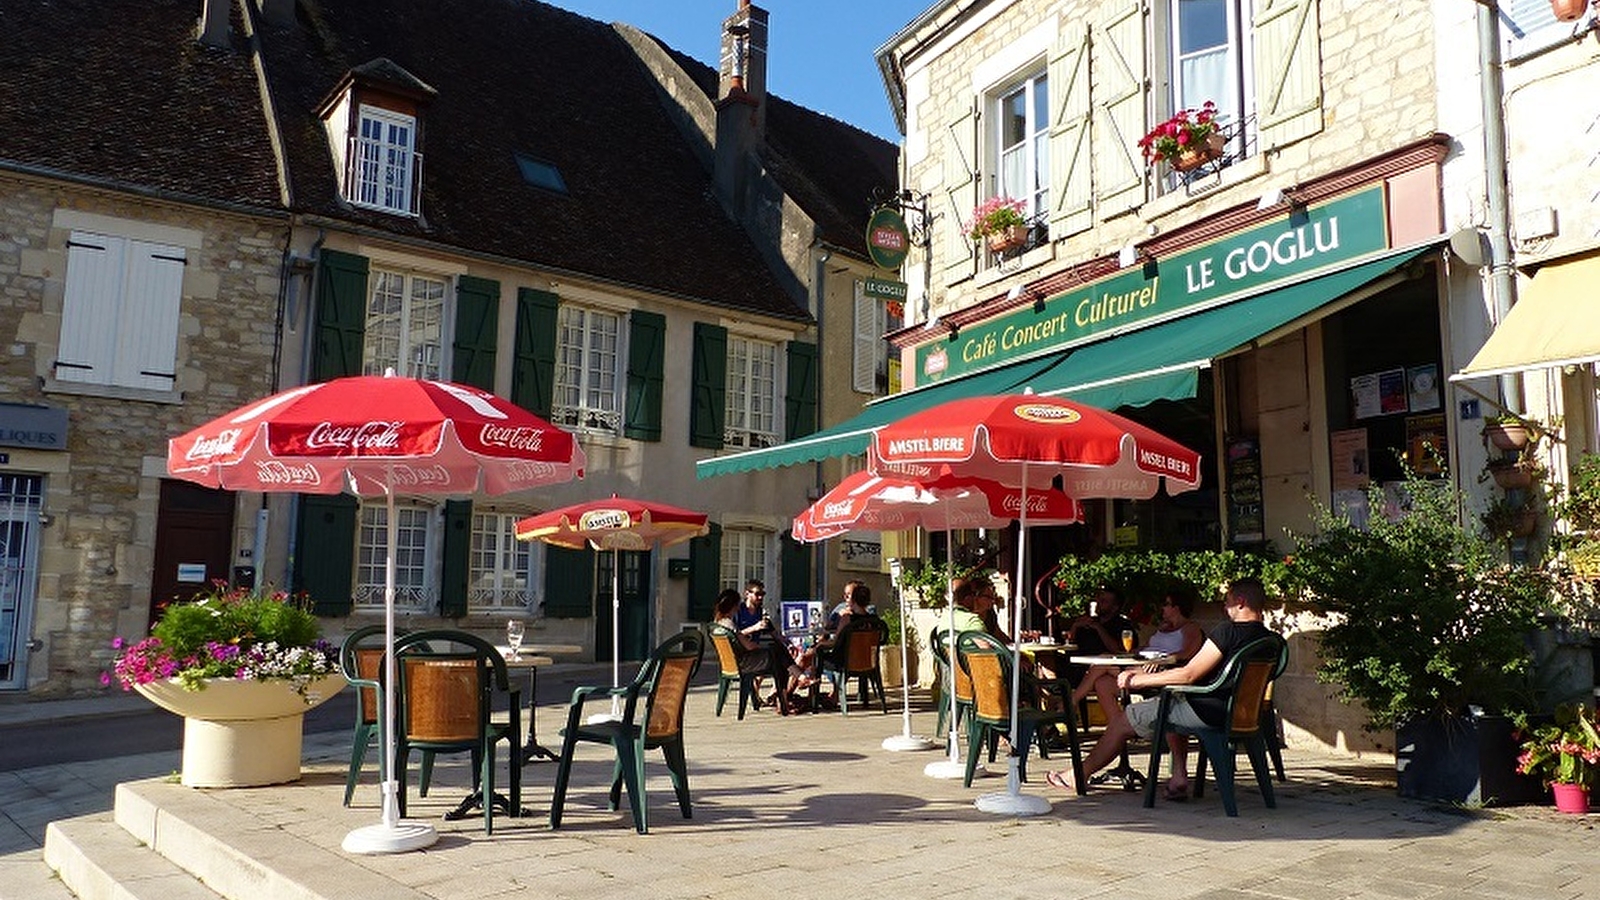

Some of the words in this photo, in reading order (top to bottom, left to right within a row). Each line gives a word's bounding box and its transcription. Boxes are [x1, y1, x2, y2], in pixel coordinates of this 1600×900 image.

[1186, 258, 1215, 294] LE
[1224, 216, 1339, 280] GOGLU
[867, 282, 875, 291] LE
[877, 284, 906, 296] GOGLU
[963, 332, 997, 363] Café
[1002, 312, 1067, 351] Concert
[1075, 277, 1160, 328] Culturel
[889, 439, 932, 455] AMSTEL
[933, 438, 964, 451] BIERE
